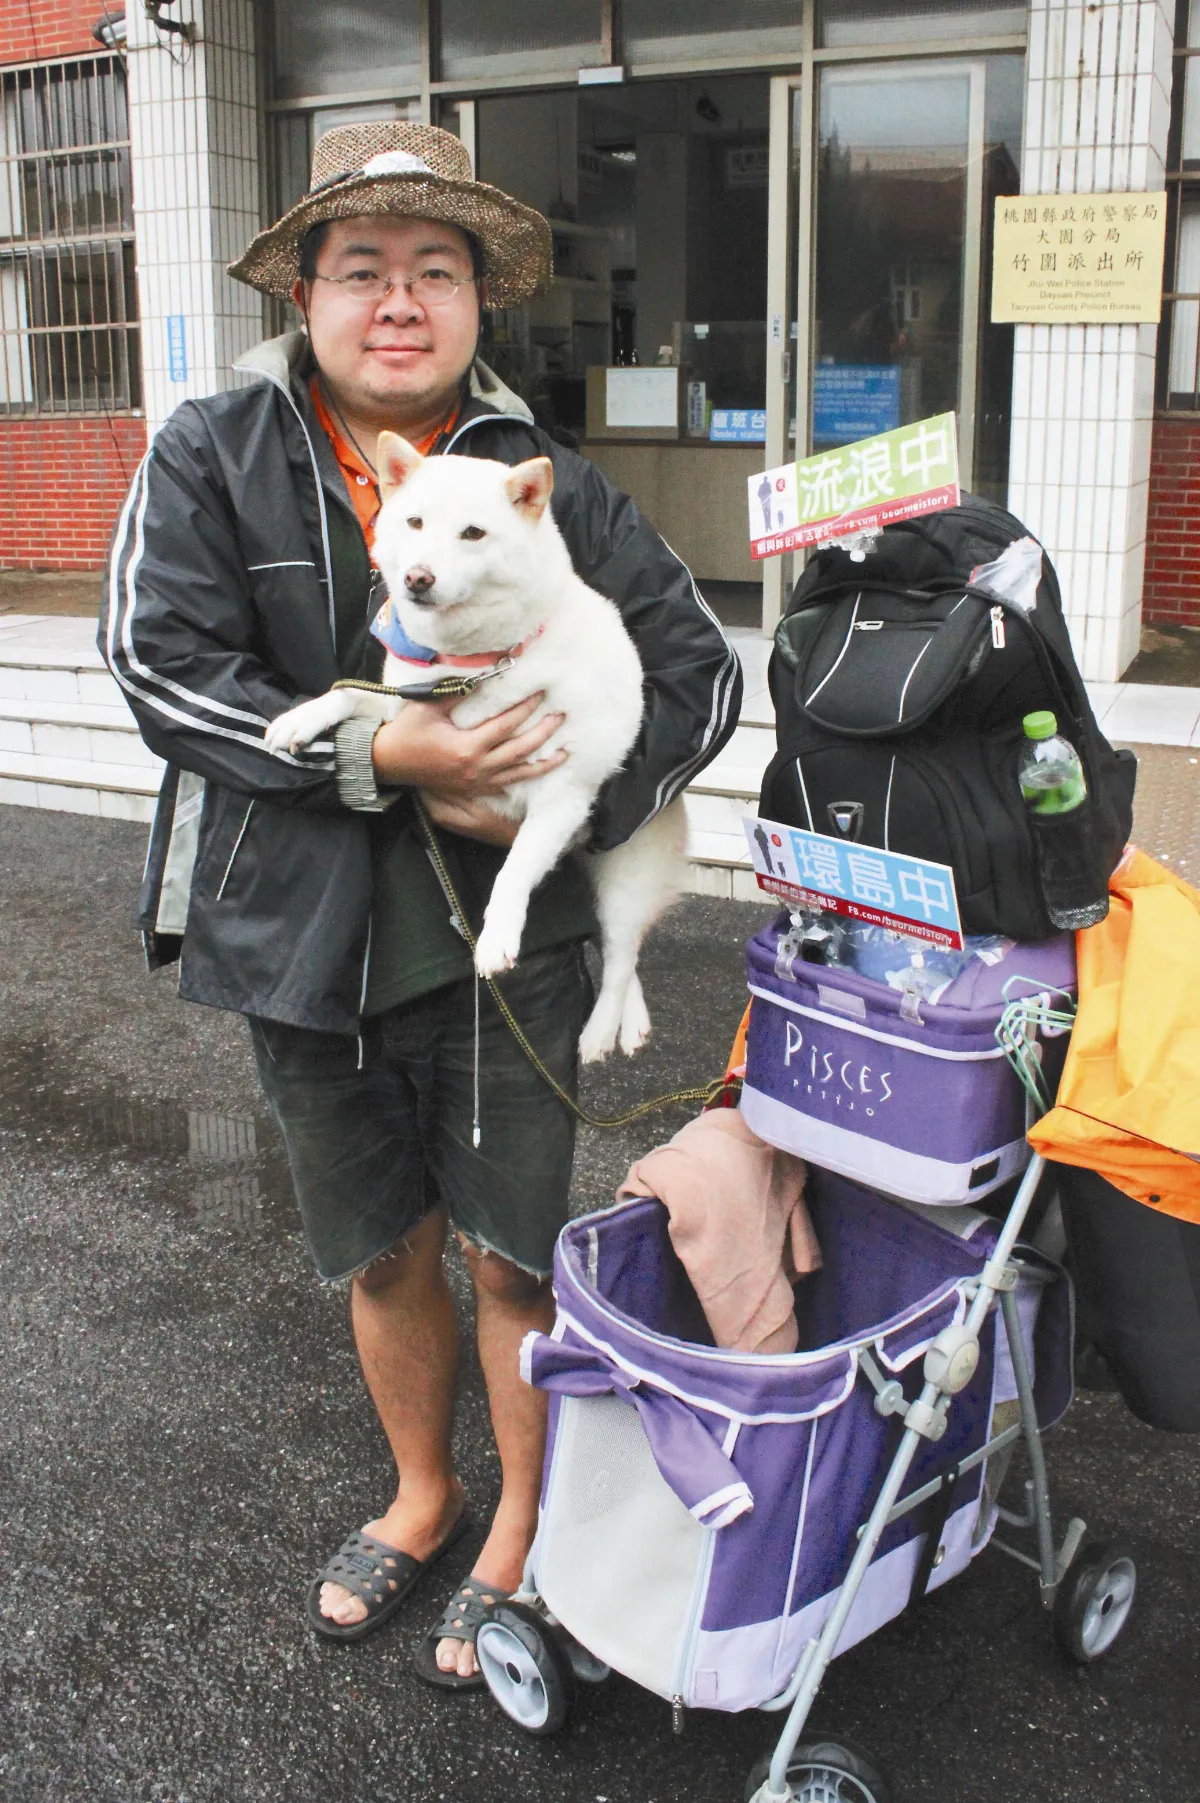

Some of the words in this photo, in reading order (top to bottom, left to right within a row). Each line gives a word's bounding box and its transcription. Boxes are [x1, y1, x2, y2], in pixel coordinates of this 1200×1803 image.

[1003, 204, 1158, 225] 桃園縣政府警察局
[1037, 227, 1120, 244] 大園分局
[1065, 279, 1092, 287] Police
[1094, 279, 1125, 287] Station
[1040, 291, 1073, 300] Dayuan
[1075, 290, 1111, 298] Precinct
[1011, 303, 1046, 312] Taoyuan
[1048, 303, 1078, 312] County
[1080, 302, 1108, 310] Police
[1110, 302, 1141, 310] Bureau
[800, 424, 949, 519] 流浪中
[794, 837, 949, 919] 環島中
